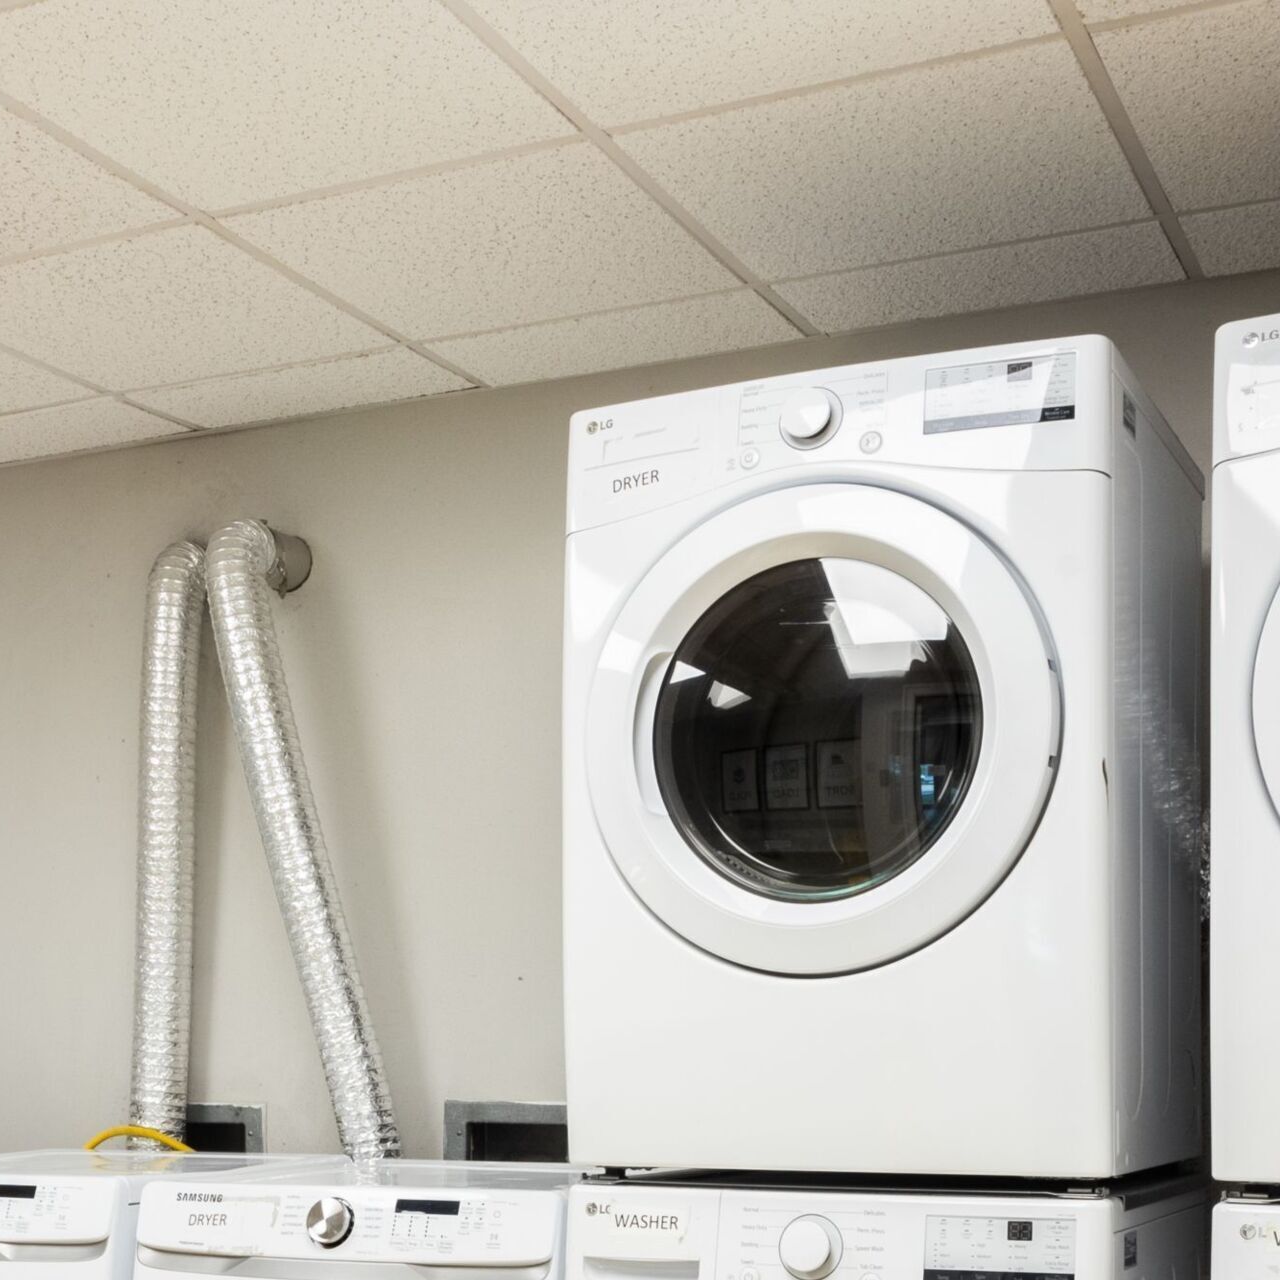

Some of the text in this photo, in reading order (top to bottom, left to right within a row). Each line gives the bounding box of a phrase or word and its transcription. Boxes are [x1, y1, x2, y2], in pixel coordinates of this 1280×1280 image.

[1261, 329, 1280, 342] LG
[613, 469, 660, 493] DRYER
[176, 1192, 223, 1203] SAMSUNG
[188, 1213, 227, 1226] DRYER
[615, 1214, 679, 1230] WASHER
